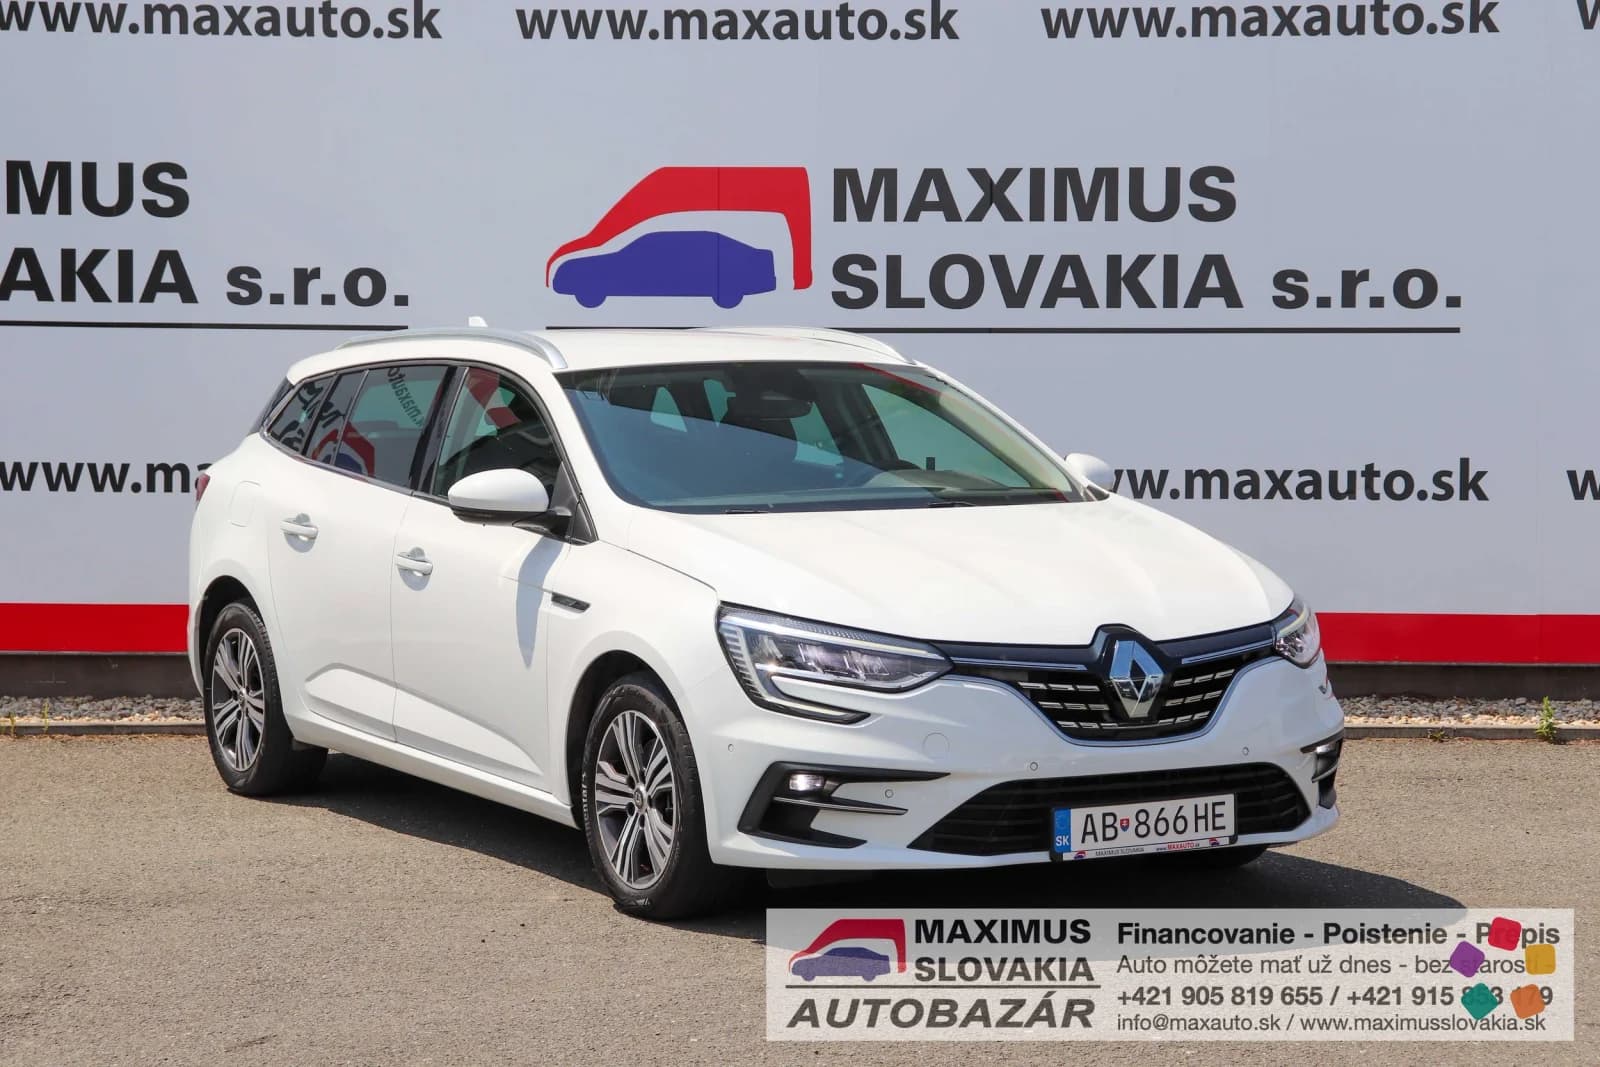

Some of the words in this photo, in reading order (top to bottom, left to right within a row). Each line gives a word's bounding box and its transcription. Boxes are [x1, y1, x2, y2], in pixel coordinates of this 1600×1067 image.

[516, 0, 960, 41] www.maxauto.sk
[1041, 0, 1500, 38] www.maxauto.sk
[6, 160, 190, 218] MUS
[833, 166, 1237, 223] MAXIMUS
[0, 248, 199, 304] AKIA
[226, 265, 409, 307] s.r.o.
[831, 254, 1244, 310] SLOVAKIA
[1271, 268, 1462, 310] s.r.o.
[1055, 835, 1070, 846] SK
[1081, 812, 1119, 844] AB
